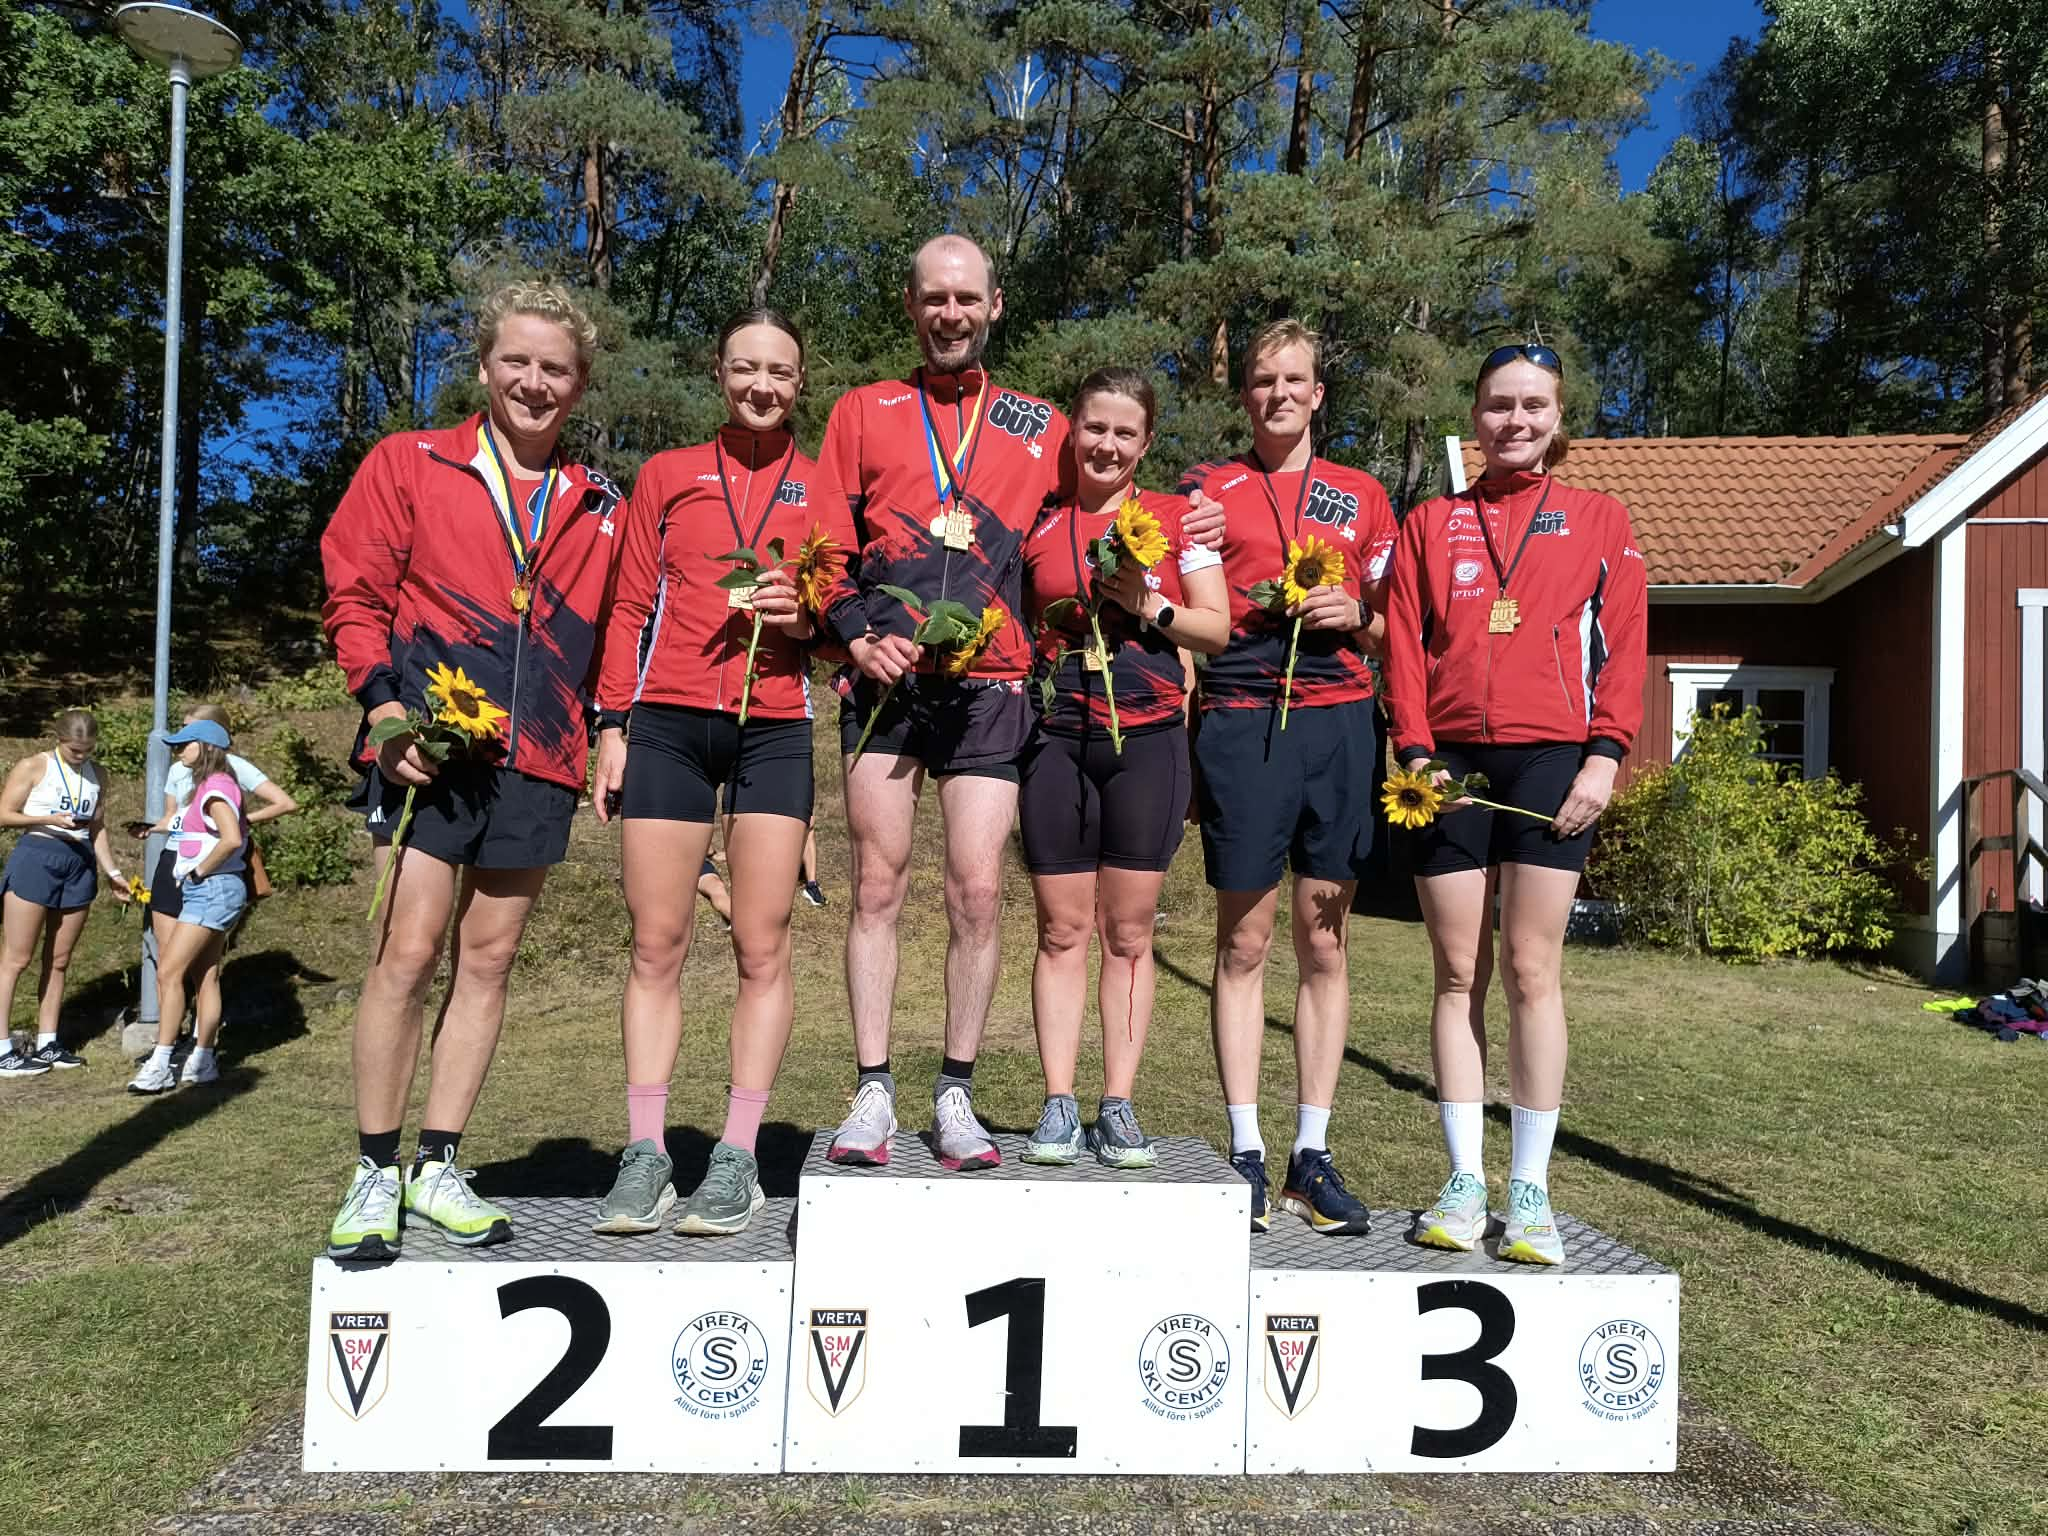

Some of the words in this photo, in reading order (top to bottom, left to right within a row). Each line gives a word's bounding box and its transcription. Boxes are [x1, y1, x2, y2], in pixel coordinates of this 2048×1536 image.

[988, 398, 1048, 444] OUT
[1490, 608, 1519, 623] OUT
[60, 796, 90, 813] 50
[336, 1315, 384, 1328] VRETA
[693, 1314, 749, 1334] VRETA
[817, 1312, 862, 1324] VRETA
[1157, 1317, 1211, 1337] VRETA
[1271, 1317, 1315, 1329] VRETA
[1596, 1323, 1647, 1341] VRETA
[487, 1275, 614, 1460] 2
[958, 1277, 1077, 1458] 1
[1410, 1280, 1518, 1459] 3
[676, 1357, 696, 1391] SKI
[698, 1358, 764, 1403] CENTER
[1143, 1359, 1162, 1392] SKI
[1164, 1360, 1226, 1404] CENTER
[1582, 1363, 1601, 1394] SKI
[1603, 1363, 1662, 1406] CENTER
[674, 1396, 699, 1415] Alltid
[1141, 1398, 1165, 1417] Alltid
[1581, 1399, 1604, 1418] Alltid
